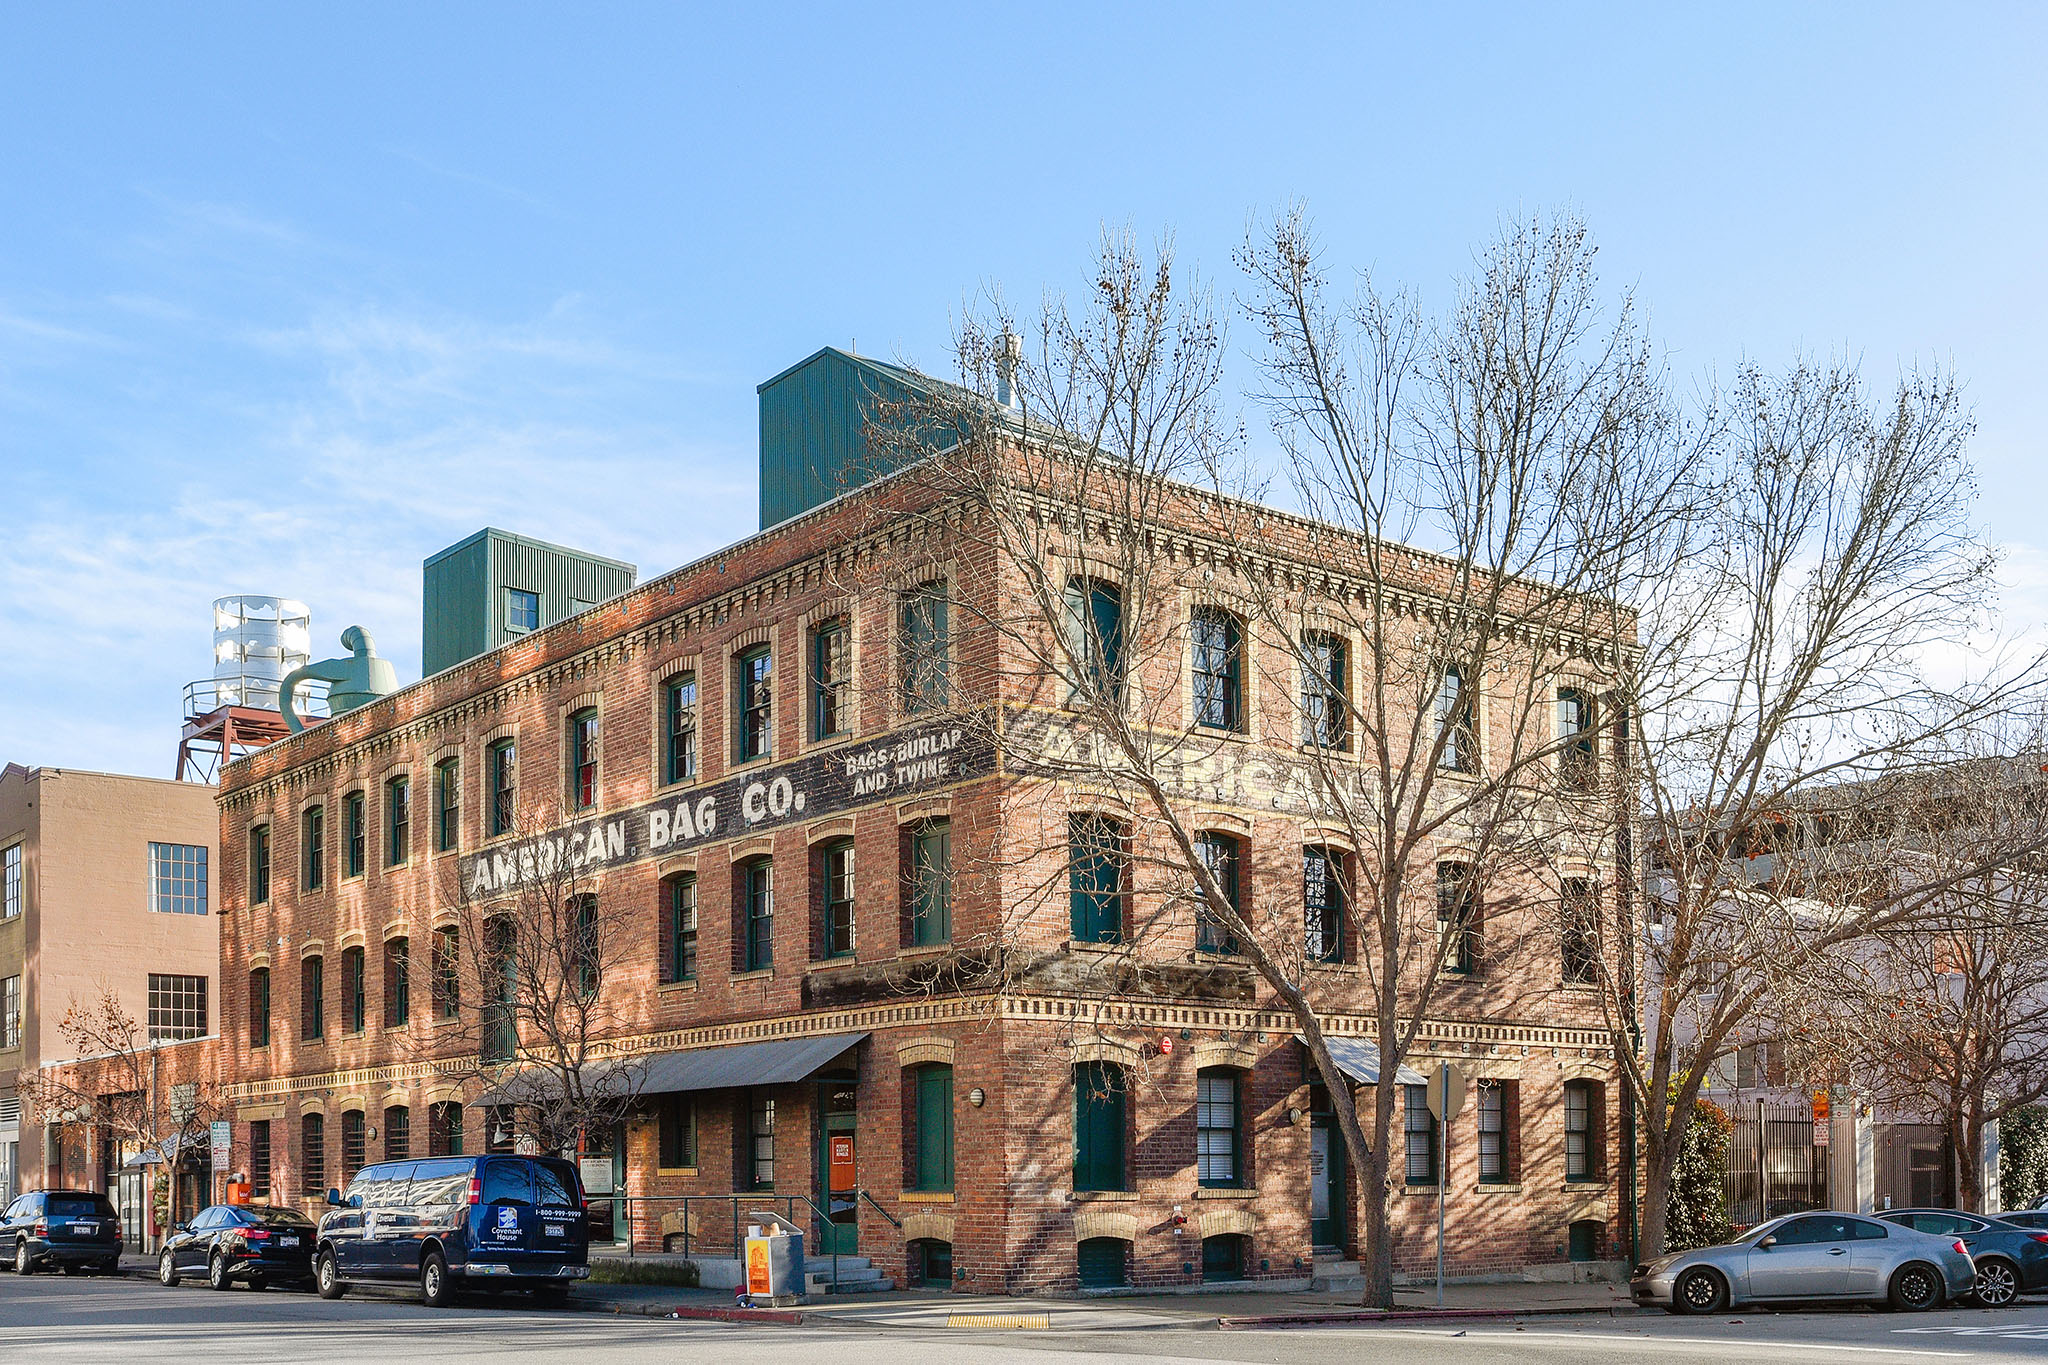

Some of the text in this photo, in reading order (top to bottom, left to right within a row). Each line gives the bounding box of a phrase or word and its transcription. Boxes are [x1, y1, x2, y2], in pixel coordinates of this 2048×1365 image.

[853, 757, 949, 797] AND TWINE
[471, 776, 806, 894] AMERICAN BAG CO.
[491, 1226, 523, 1235] Covenant
[496, 1233, 518, 1241] House
